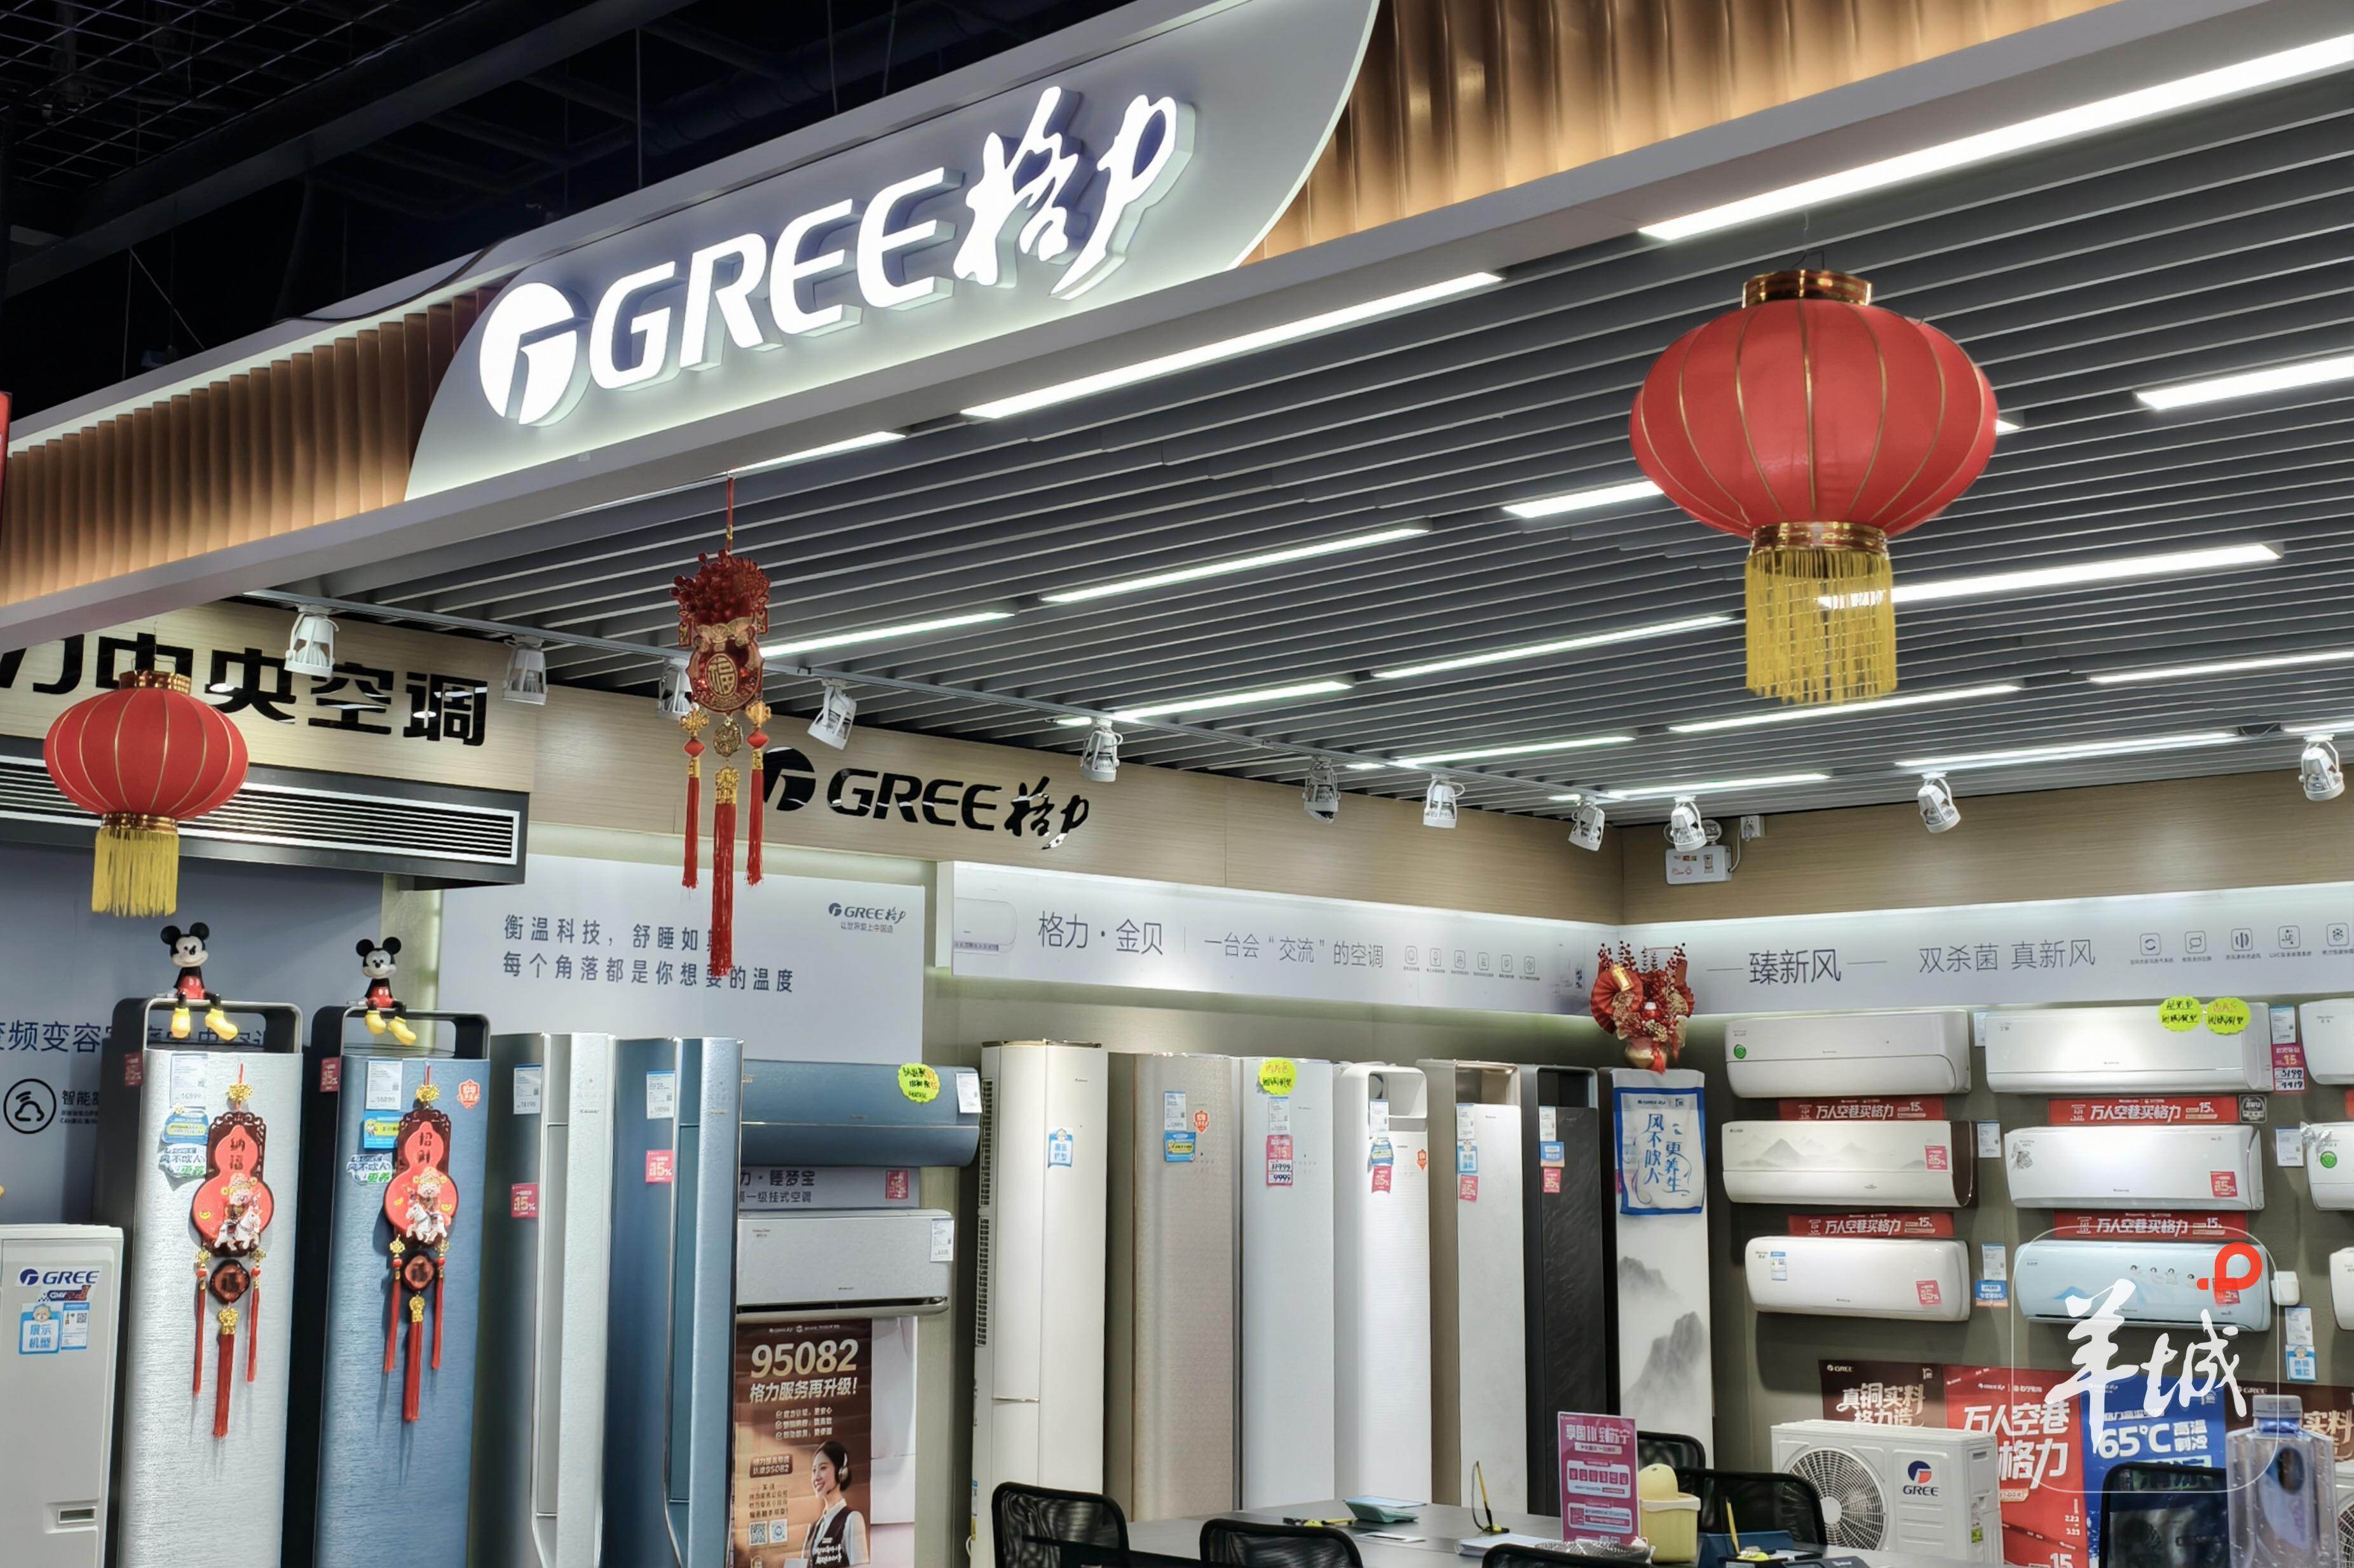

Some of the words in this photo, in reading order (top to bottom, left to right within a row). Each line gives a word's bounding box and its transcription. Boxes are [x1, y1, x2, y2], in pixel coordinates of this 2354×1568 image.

[588, 166, 950, 391] GREE
[827, 767, 1002, 831] GREE
[844, 906, 884, 920] GREE
[503, 951, 794, 994] 每个角落都是你想要的温度
[1749, 949, 1842, 985] 臻新风
[1919, 943, 1999, 975] 双杀菌
[2011, 939, 2096, 971] 真新风
[0, 1019, 112, 1053] 频变容
[1816, 1104, 1894, 1120] 万人空巷买格力
[2090, 1104, 2181, 1123] 万人空巷买格力
[1643, 1113, 1664, 1185] 风不吹人
[1825, 1219, 1901, 1235] 万人空巷买格力
[2097, 1218, 2188, 1237] 万人空巷买格力
[43, 1271, 100, 1285] GREE
[750, 1338, 859, 1379] 95082
[1835, 1382, 1926, 1416] 真铜实料
[1964, 1402, 2071, 1436] 万人空巷
[1998, 1438, 2069, 1489] 格力
[1903, 1484, 1940, 1497] GREE
